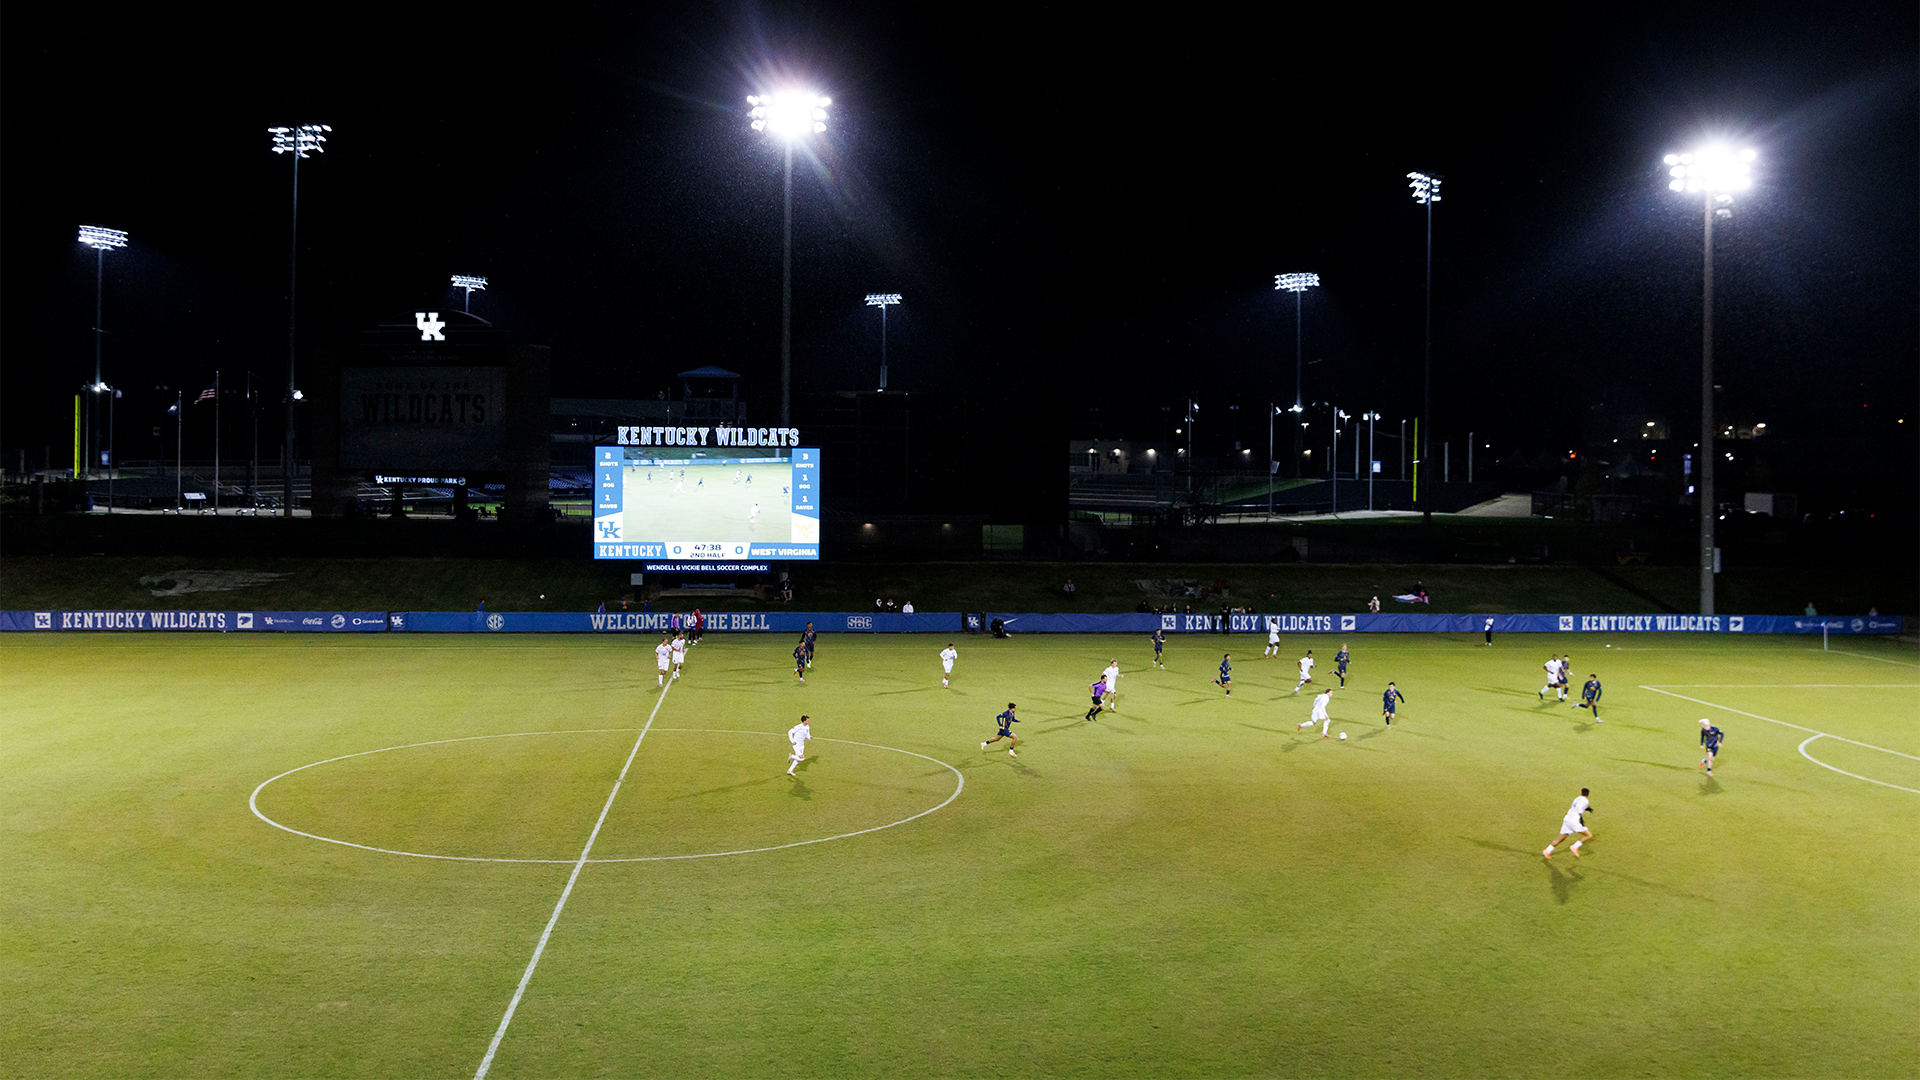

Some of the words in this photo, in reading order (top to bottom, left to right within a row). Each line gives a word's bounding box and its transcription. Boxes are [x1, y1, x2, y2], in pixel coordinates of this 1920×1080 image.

[415, 312, 445, 341] UK
[361, 393, 485, 423] WILDCATS
[617, 426, 709, 445] KENTUCKY
[716, 427, 799, 446] WILDCATS
[597, 521, 621, 539] UK
[599, 545, 662, 556] KENTUCKY
[751, 548, 777, 556] WEST
[778, 548, 817, 556] VIRGINIA
[62, 613, 145, 628] KENTUCKY
[151, 613, 225, 628] WILDCATS
[391, 616, 403, 626] UK
[488, 614, 503, 629] SEC
[590, 614, 668, 629] WELCOME
[731, 614, 770, 629] BELL
[968, 616, 979, 627] UK
[1581, 616, 1652, 631] KENTUCKY
[1656, 616, 1720, 631] WILDCATS
